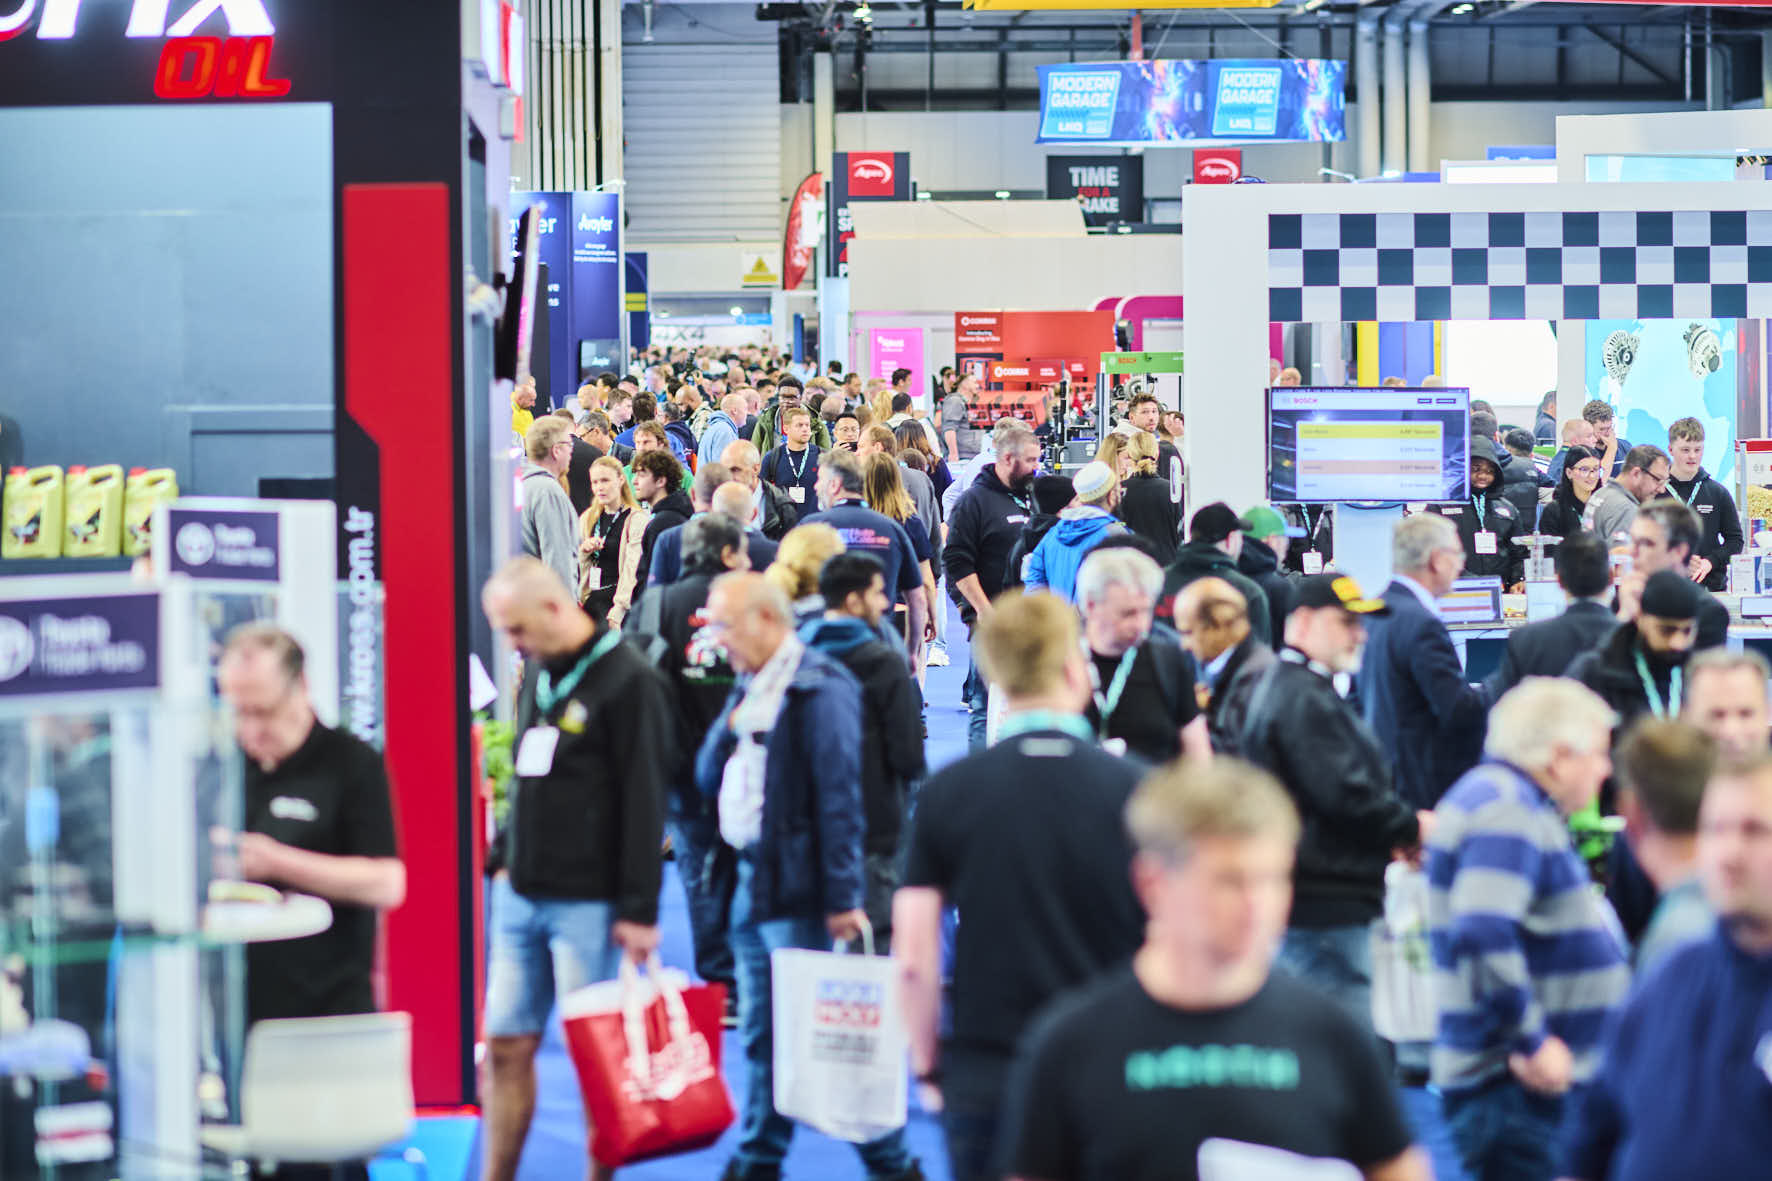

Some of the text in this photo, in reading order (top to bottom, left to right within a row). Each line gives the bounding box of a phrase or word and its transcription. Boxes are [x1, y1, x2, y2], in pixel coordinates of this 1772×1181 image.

[154, 36, 291, 98] OIL
[1052, 76, 1115, 92] MODERN
[1222, 71, 1276, 88] MODERN
[1051, 92, 1110, 107] GARAGE
[1221, 88, 1273, 104] GARAGE
[1068, 166, 1119, 187] TIME
[1102, 187, 1111, 198] A
